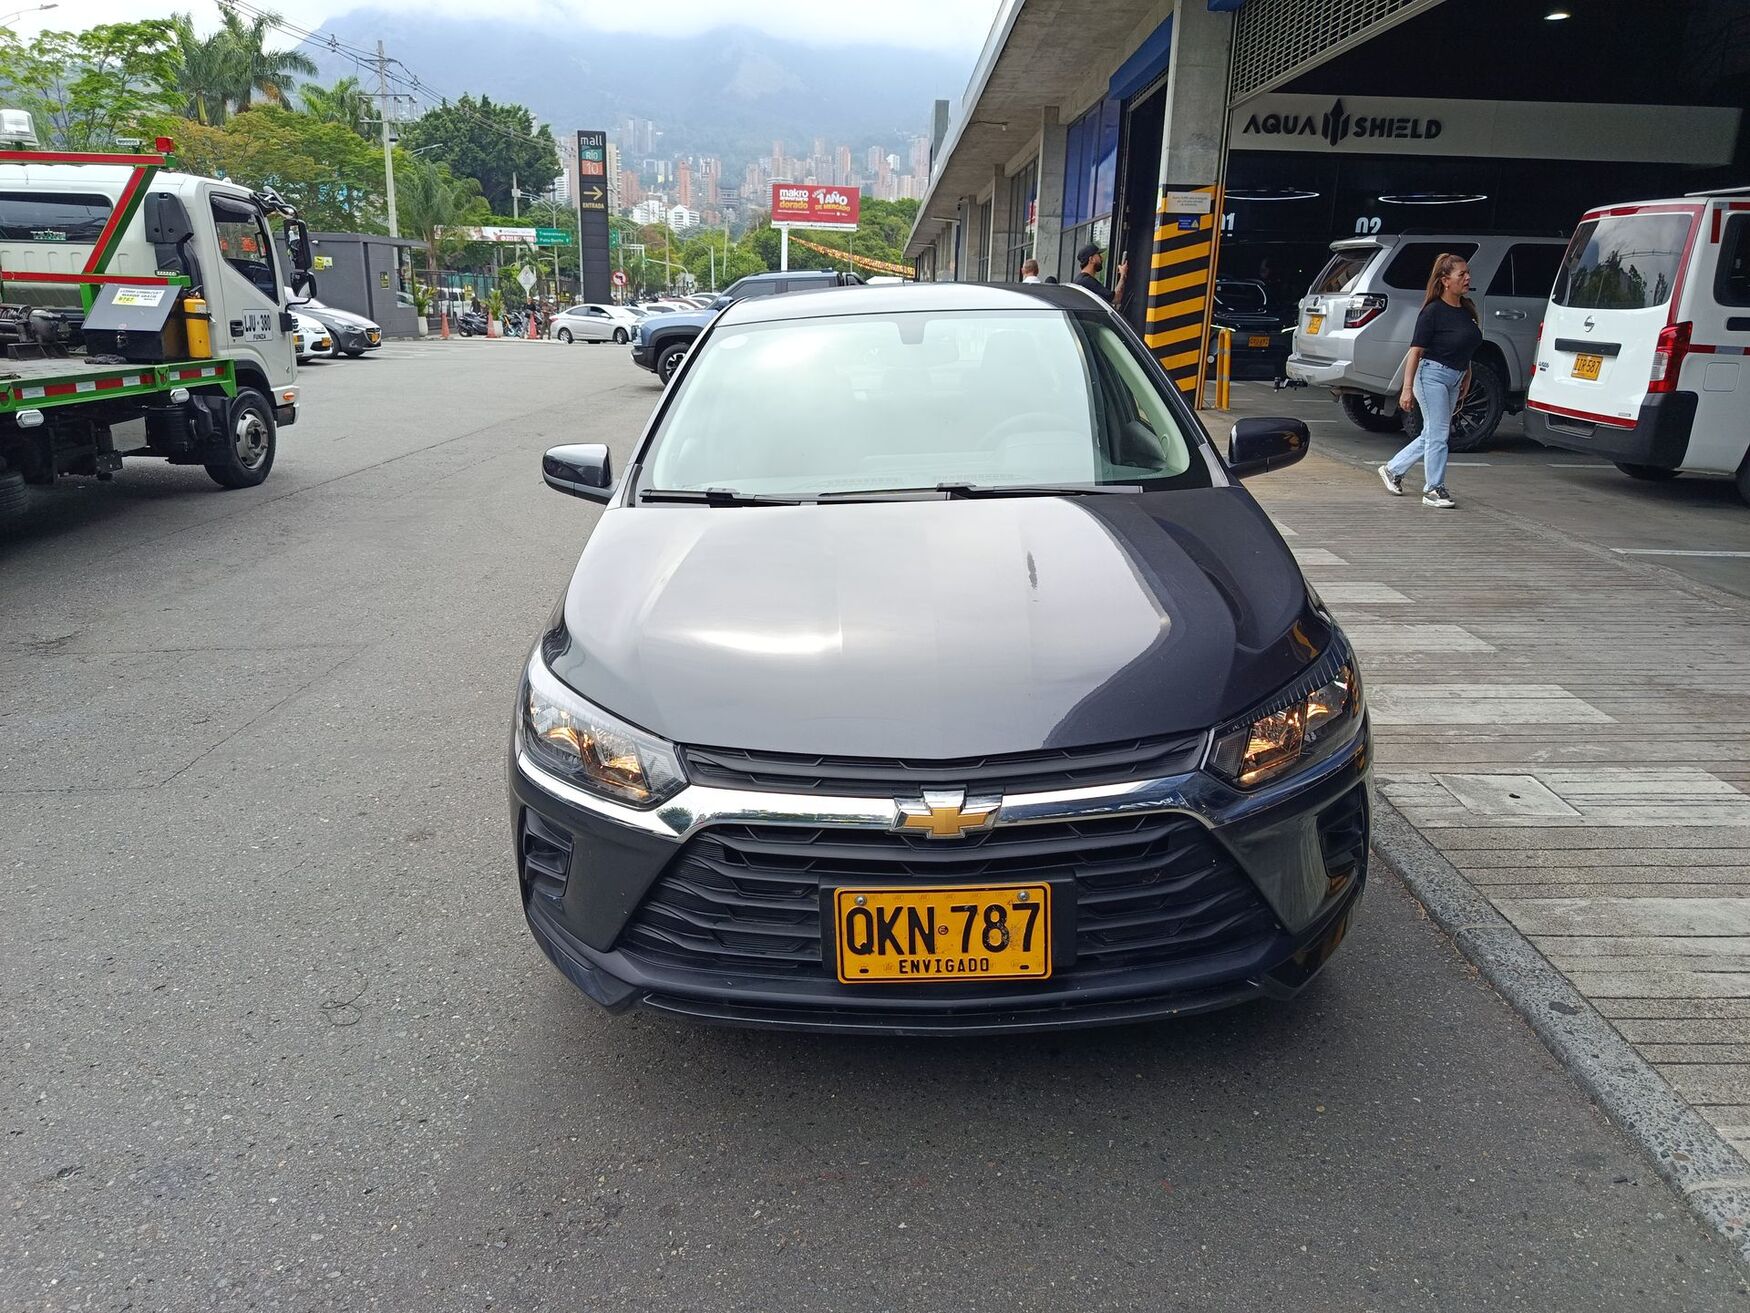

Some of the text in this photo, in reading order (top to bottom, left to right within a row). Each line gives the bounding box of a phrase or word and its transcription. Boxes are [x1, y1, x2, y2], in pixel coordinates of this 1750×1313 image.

[1243, 114, 1442, 139] AQUA SHIELD
[580, 135, 603, 146] mall
[586, 162, 599, 174] 10
[780, 188, 809, 198] makro
[825, 191, 848, 205] AÑO
[780, 200, 808, 209] dorado
[845, 903, 1041, 956] QKN 787
[899, 957, 989, 974] ENVIGADO
